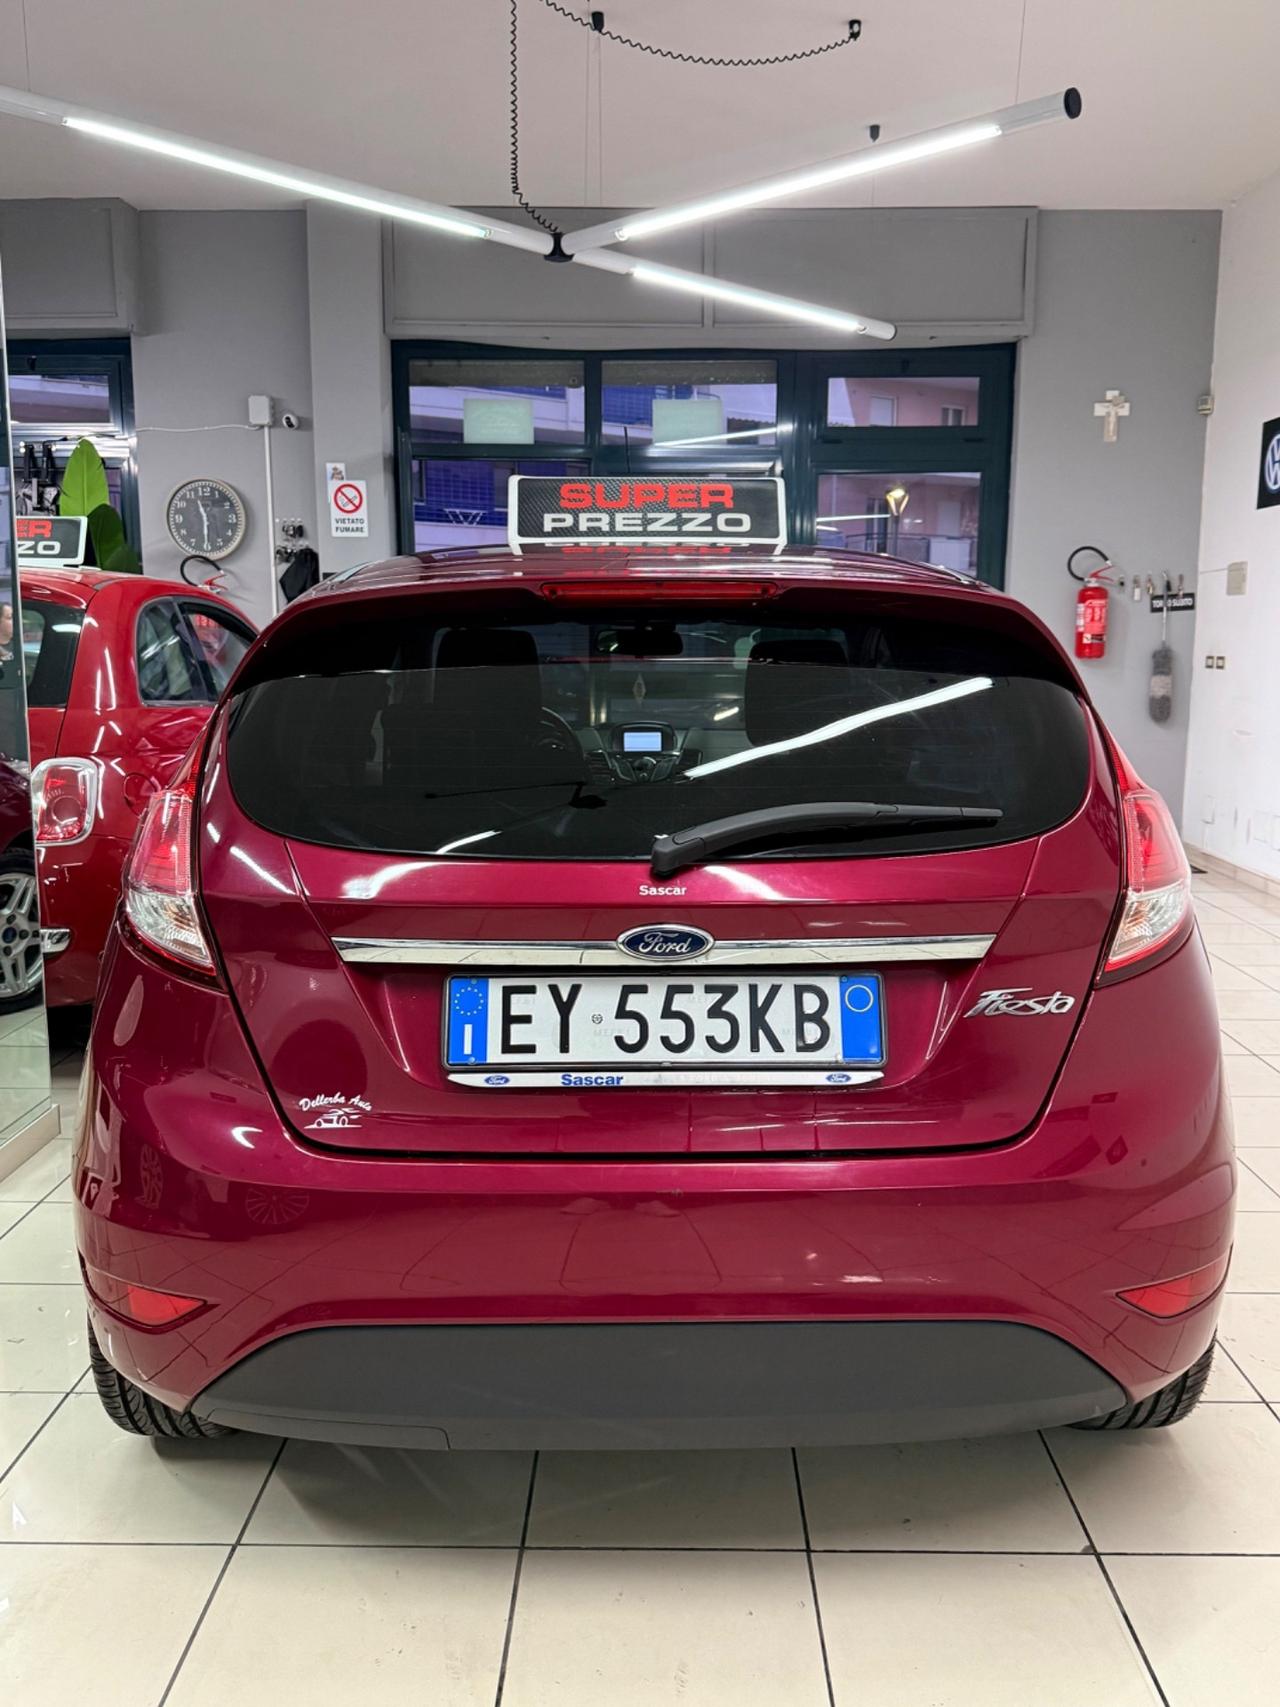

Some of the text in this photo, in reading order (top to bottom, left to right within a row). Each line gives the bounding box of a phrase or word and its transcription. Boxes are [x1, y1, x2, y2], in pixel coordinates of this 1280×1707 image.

[560, 483, 735, 509] SUPER
[543, 512, 752, 533] PREZZO
[1152, 599, 1172, 608] TORO
[639, 885, 687, 896] Sascar
[638, 932, 692, 954] Ford
[963, 987, 1076, 1018] Fiesta
[501, 983, 831, 1054] EY 553KB
[561, 1074, 624, 1086] Sascar
